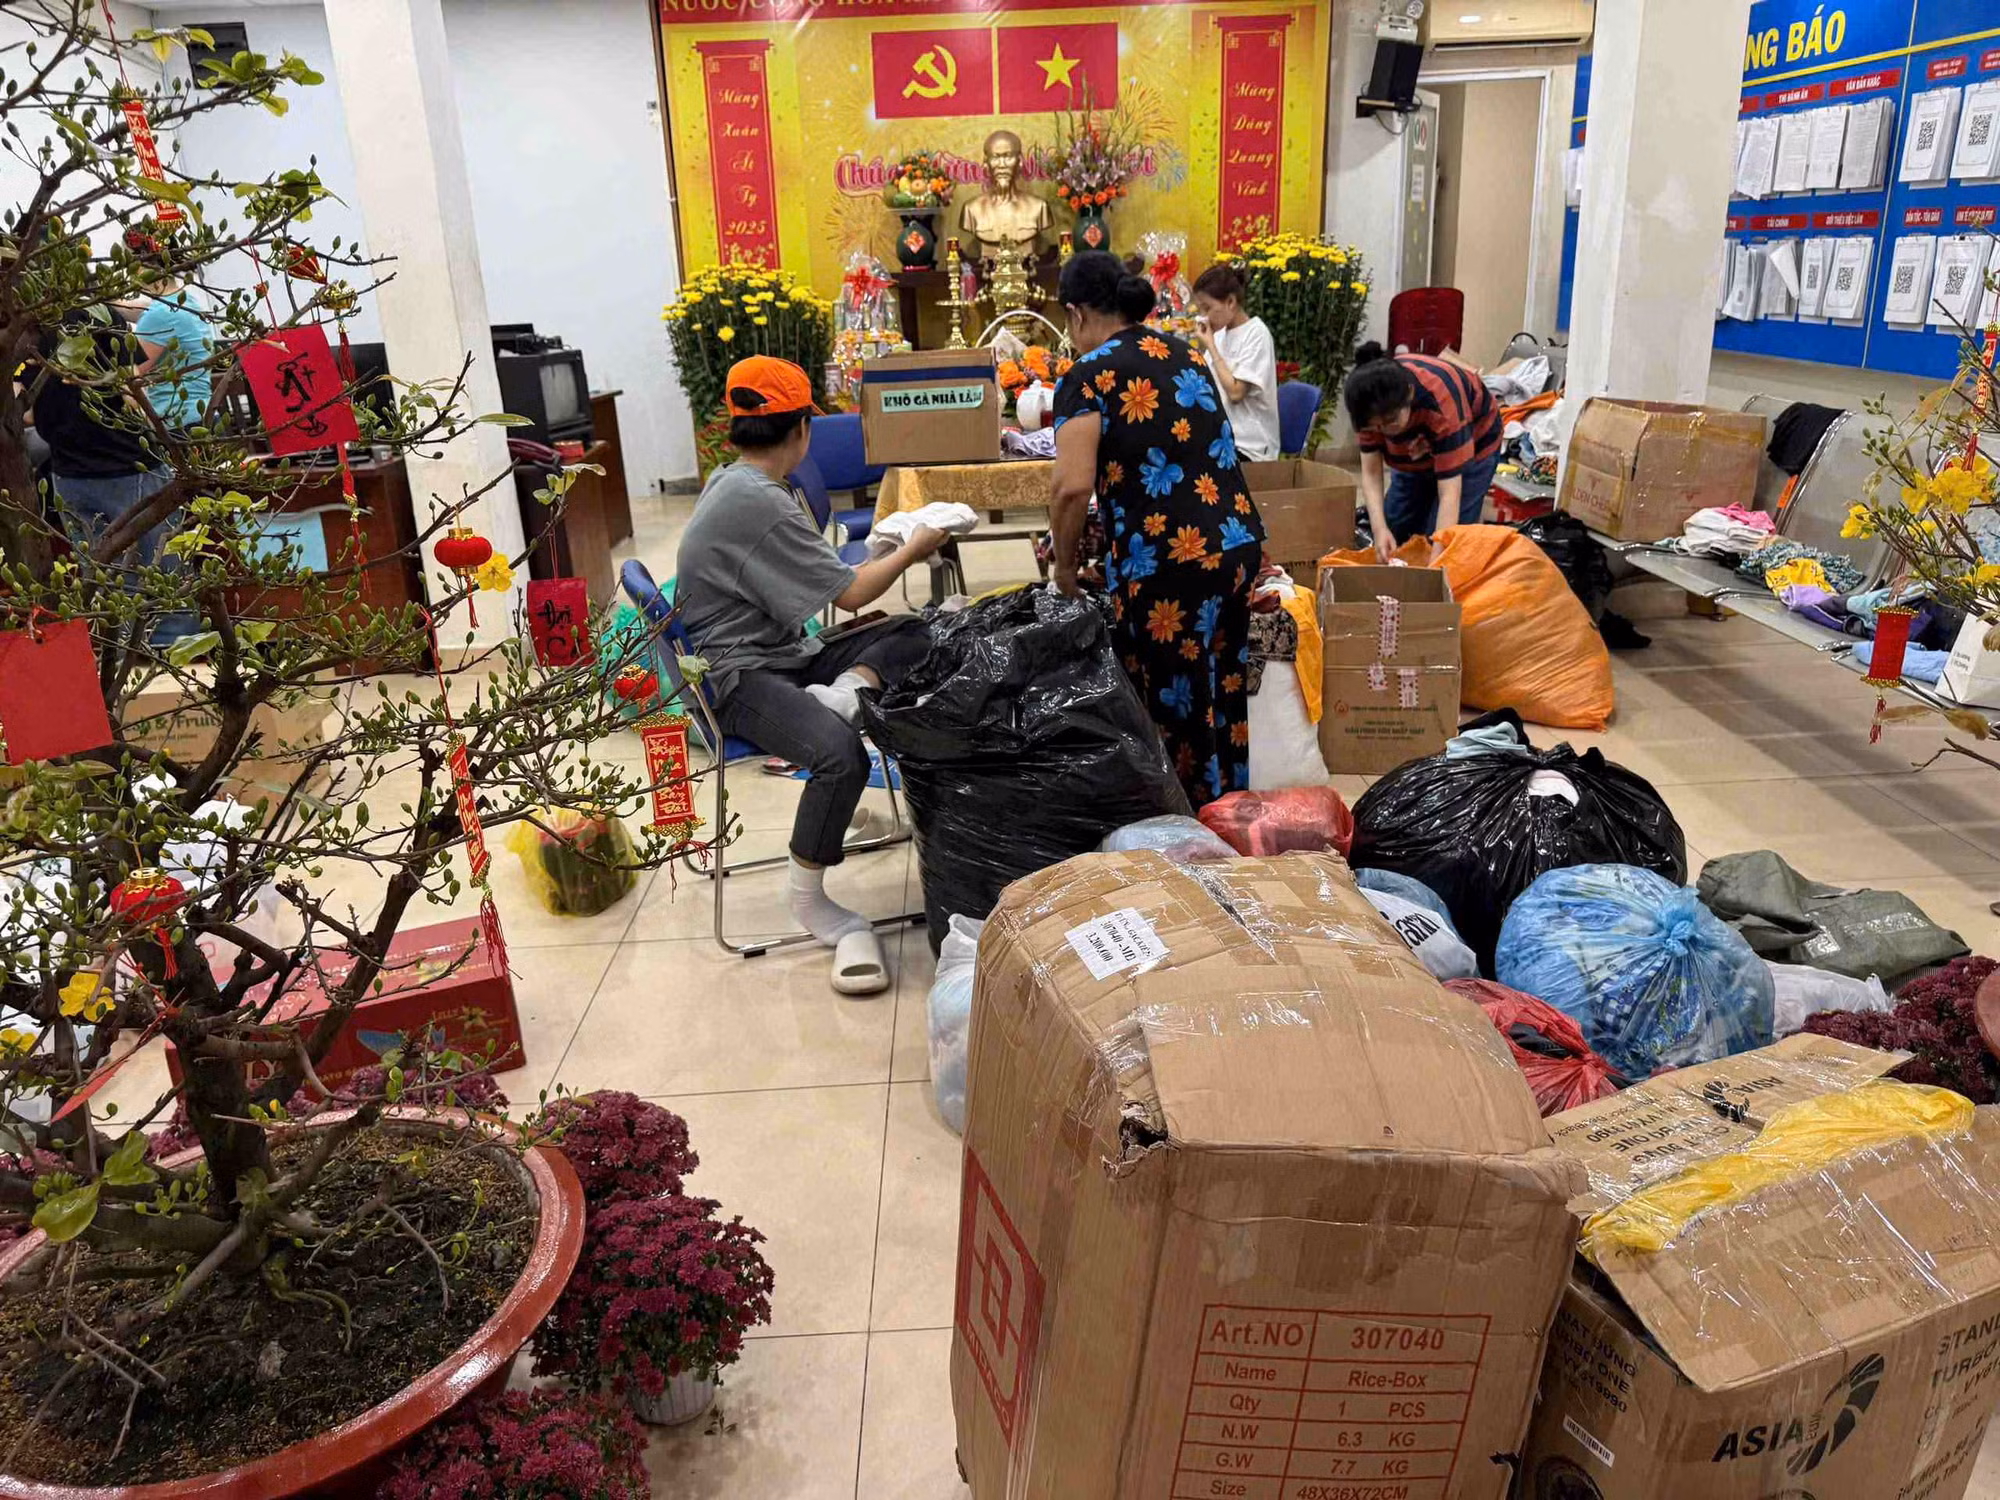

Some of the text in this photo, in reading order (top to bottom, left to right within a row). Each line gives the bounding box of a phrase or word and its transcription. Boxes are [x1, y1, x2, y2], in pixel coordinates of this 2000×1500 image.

[1785, 4, 1846, 62] BÁO
[1227, 149, 1274, 168] Quang
[725, 220, 767, 236] 2025
[884, 393, 911, 407] KHÔ
[913, 391, 929, 405] GÀ
[932, 390, 957, 405] NHÀ
[1741, 1076, 1784, 1096] ASIA
[1609, 1133, 1650, 1152] ONE
[1210, 1319, 1445, 1350] Art.NO 307040
[1224, 1362, 1427, 1388] Name Rice-Box
[1599, 1363, 1630, 1394] ONE
[1229, 1394, 1426, 1418] Qty 1 PCS
[1221, 1424, 1416, 1448] N.W 6.3 KG
[1711, 1417, 1803, 1463] ASIA
[1215, 1452, 1410, 1476] G.W 7.7 KG
[1210, 1480, 1247, 1496] Size
